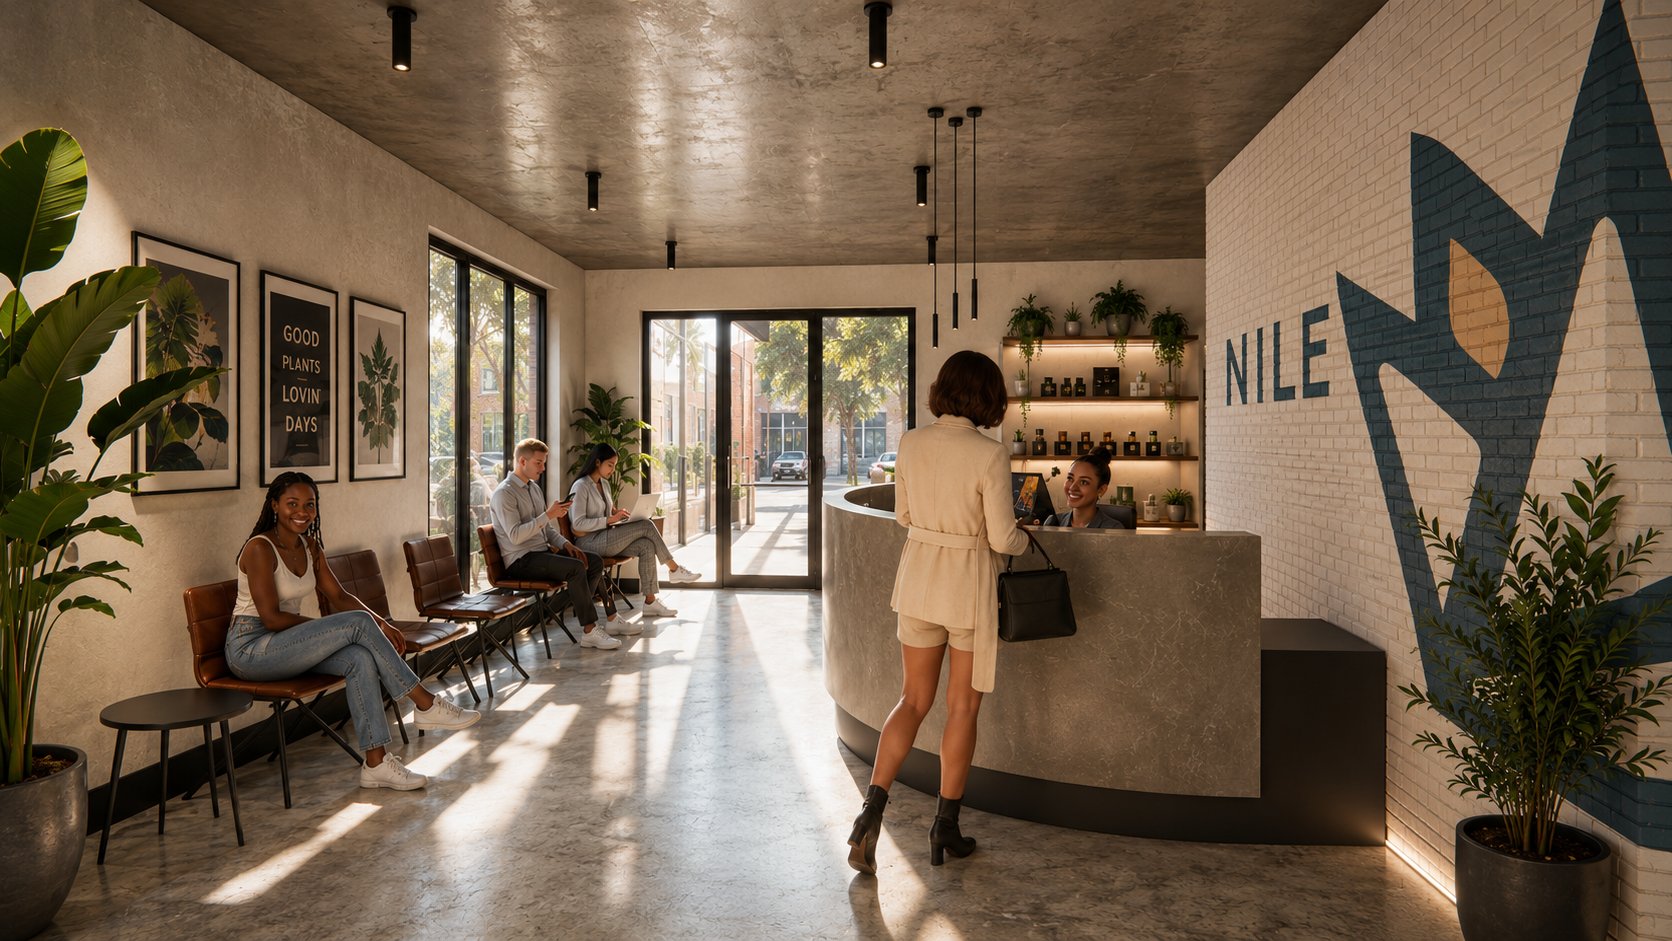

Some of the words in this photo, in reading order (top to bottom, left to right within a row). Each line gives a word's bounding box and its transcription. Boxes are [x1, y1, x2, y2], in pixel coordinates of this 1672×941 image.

[283, 324, 320, 347] GOOD
[282, 355, 321, 374] PLANTS
[1226, 303, 1329, 406] NILE
[285, 415, 318, 433] DAYS
